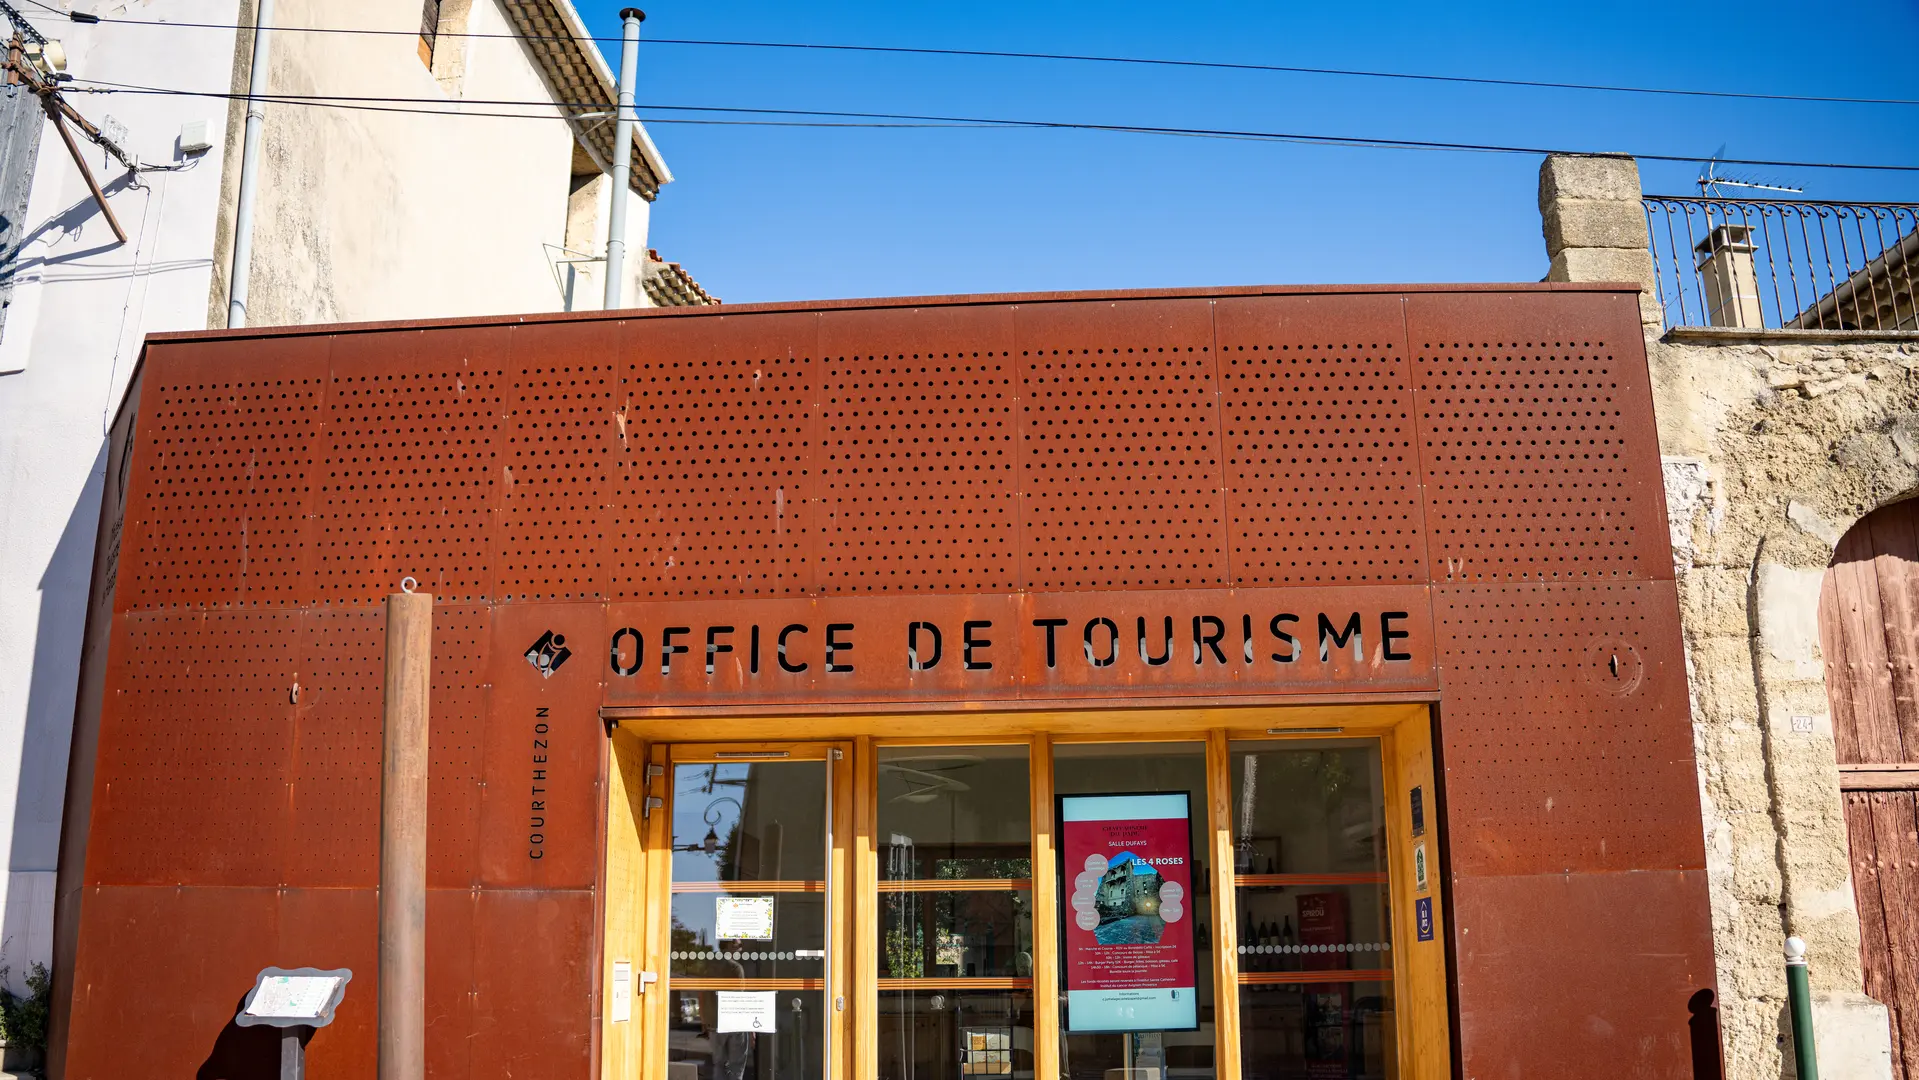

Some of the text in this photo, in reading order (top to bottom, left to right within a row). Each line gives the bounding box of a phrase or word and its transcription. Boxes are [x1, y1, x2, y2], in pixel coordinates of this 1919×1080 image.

[610, 611, 1412, 676] OFFICE DE TOURISME
[1796, 719, 1808, 729] 24
[529, 707, 549, 859] COURTHEZON
